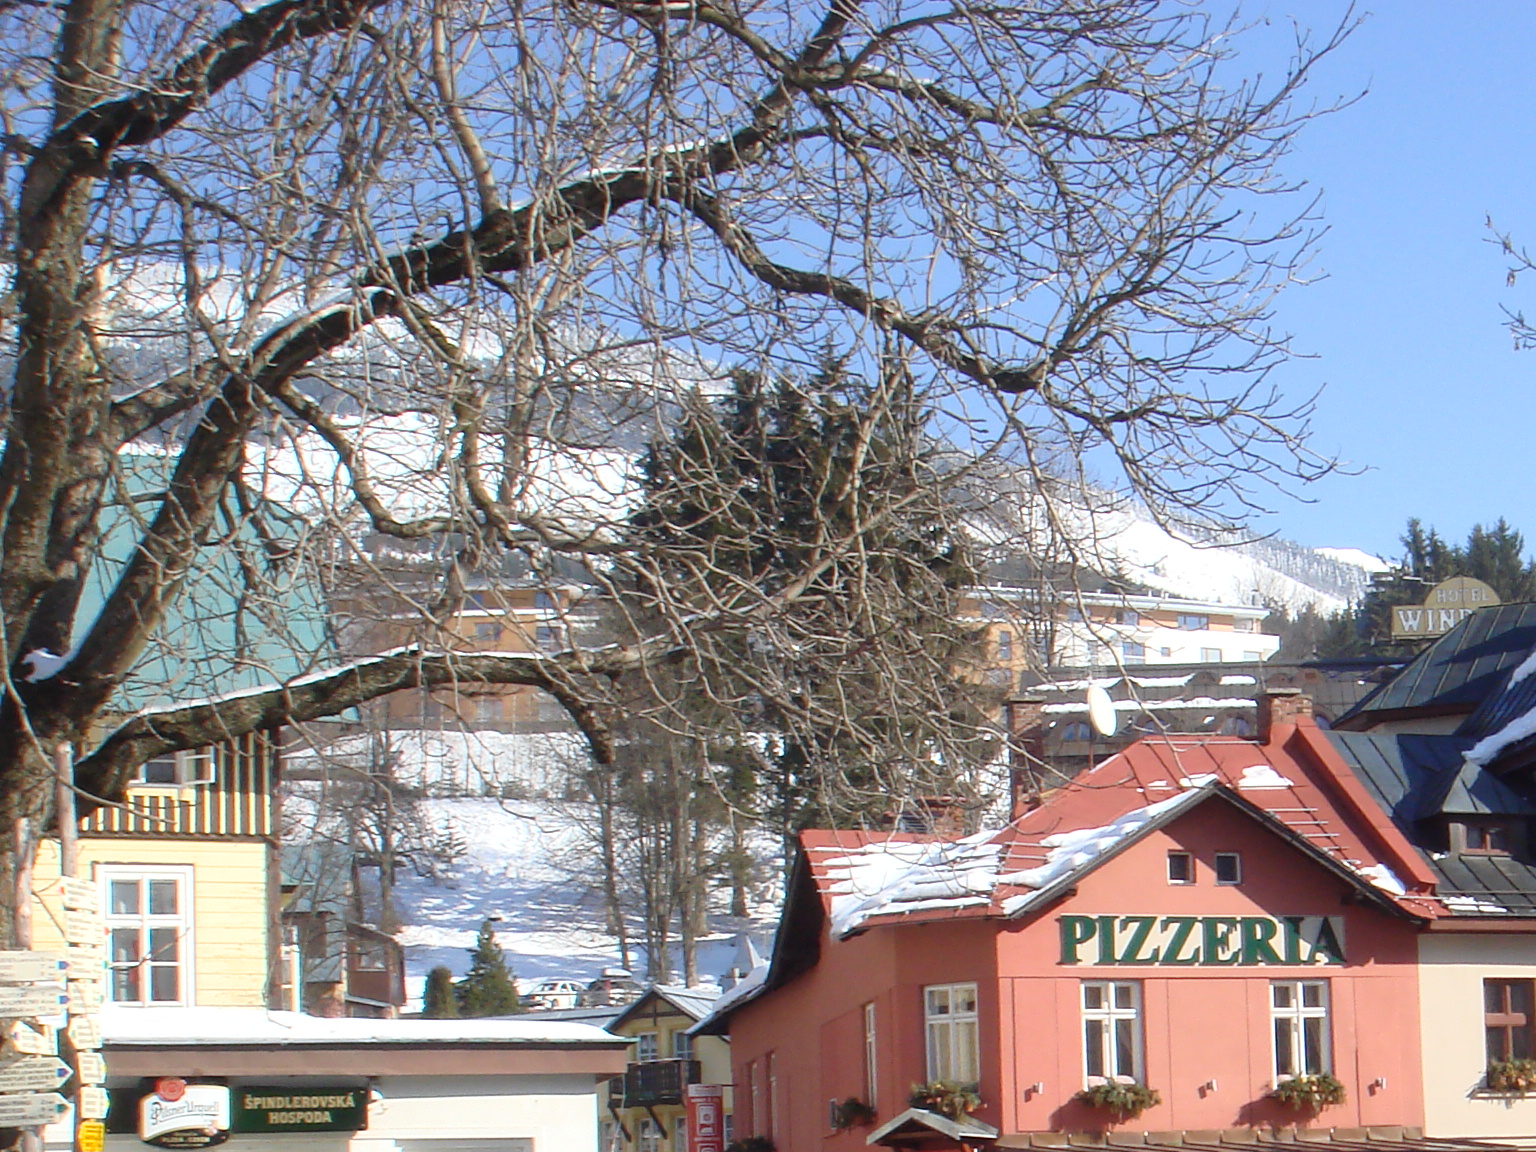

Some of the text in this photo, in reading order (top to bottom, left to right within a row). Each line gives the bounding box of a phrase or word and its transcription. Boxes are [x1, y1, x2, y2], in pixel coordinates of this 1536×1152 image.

[1437, 588, 1490, 603] HOTEL
[1055, 915, 1347, 966] PIZZERIA
[244, 1092, 356, 1110] ŠPINDLEROVSKÁ
[267, 1110, 332, 1125] HOSPODA
